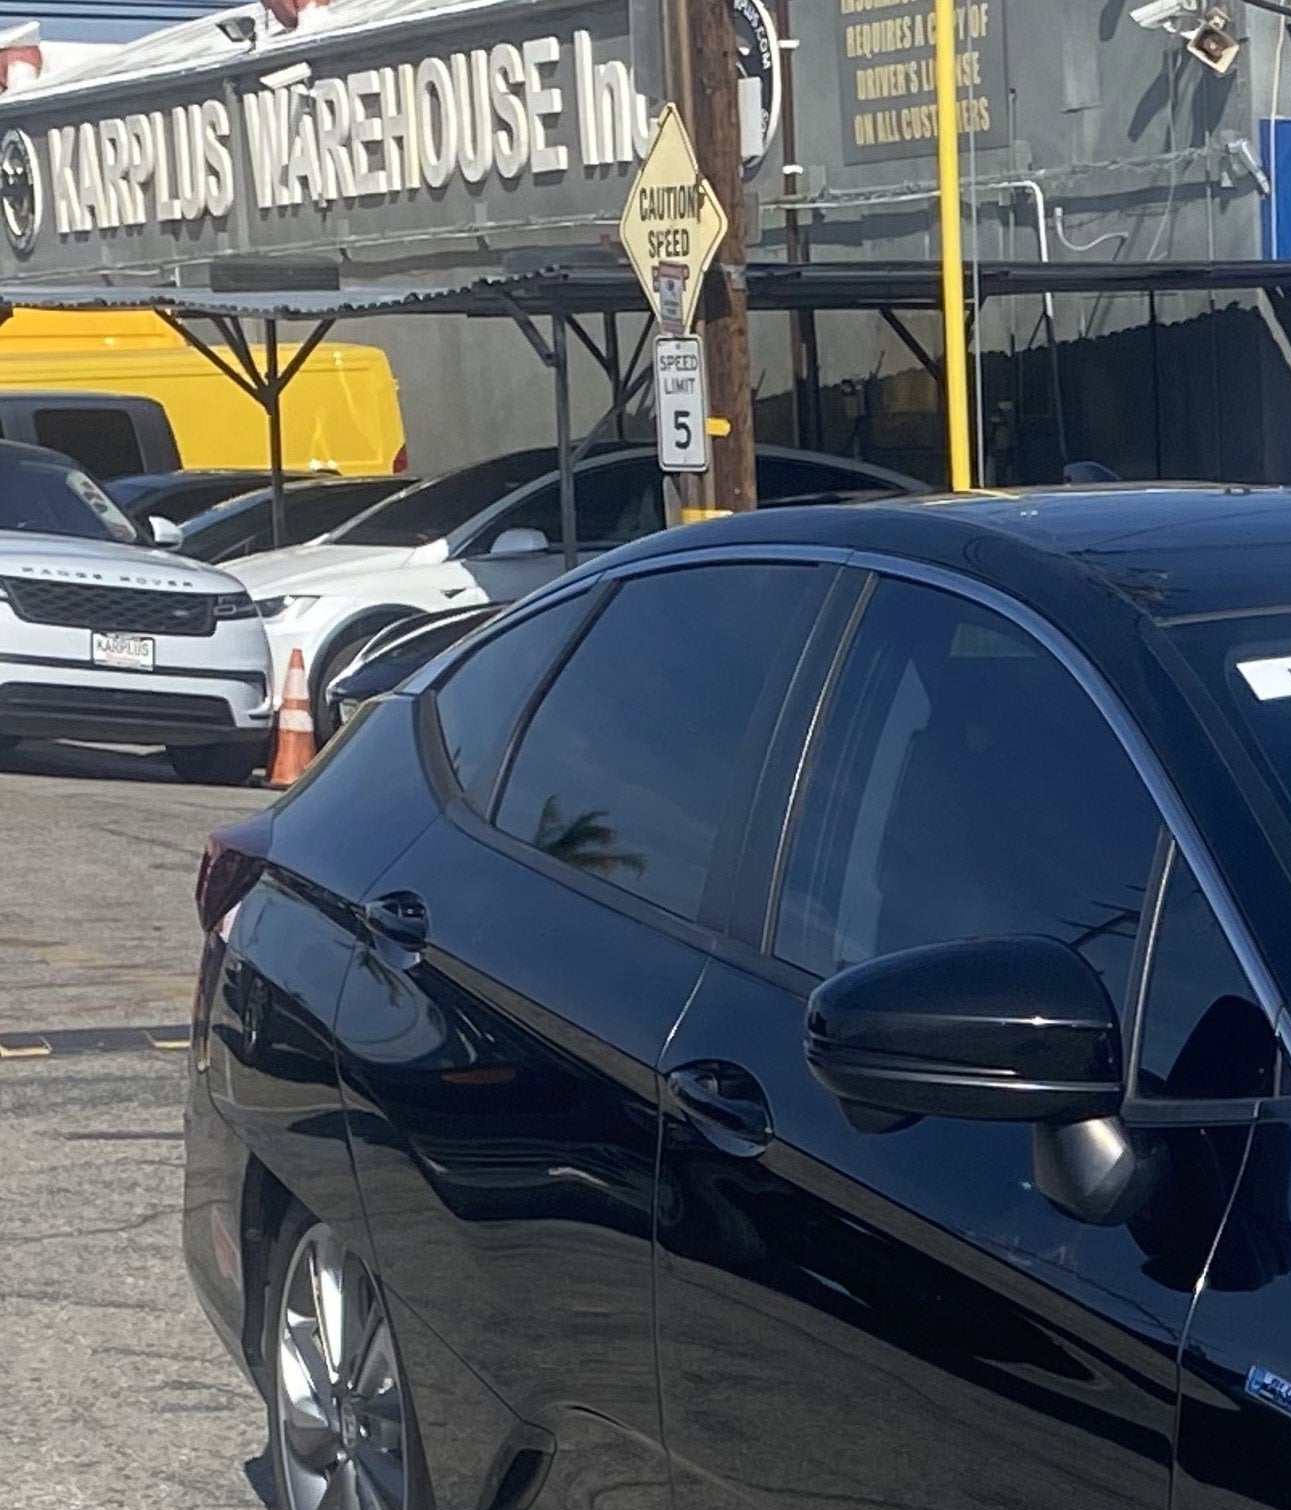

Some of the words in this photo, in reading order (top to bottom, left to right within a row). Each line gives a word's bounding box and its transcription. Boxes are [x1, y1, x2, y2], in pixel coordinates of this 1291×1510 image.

[846, 16, 912, 58] REQUIRES
[914, 14, 925, 47] A
[967, 3, 988, 39] OF
[856, 61, 919, 100] DRIVER'S
[48, 100, 233, 233] KARPLUS
[243, 36, 568, 208] WAREHOUSE
[855, 113, 875, 147] ON
[876, 110, 900, 144] ALL
[639, 184, 699, 222] CAUTION
[648, 229, 690, 258] SPEED
[660, 354, 698, 371] SPEED
[665, 377, 695, 395] LIMIT
[674, 410, 692, 449] 5
